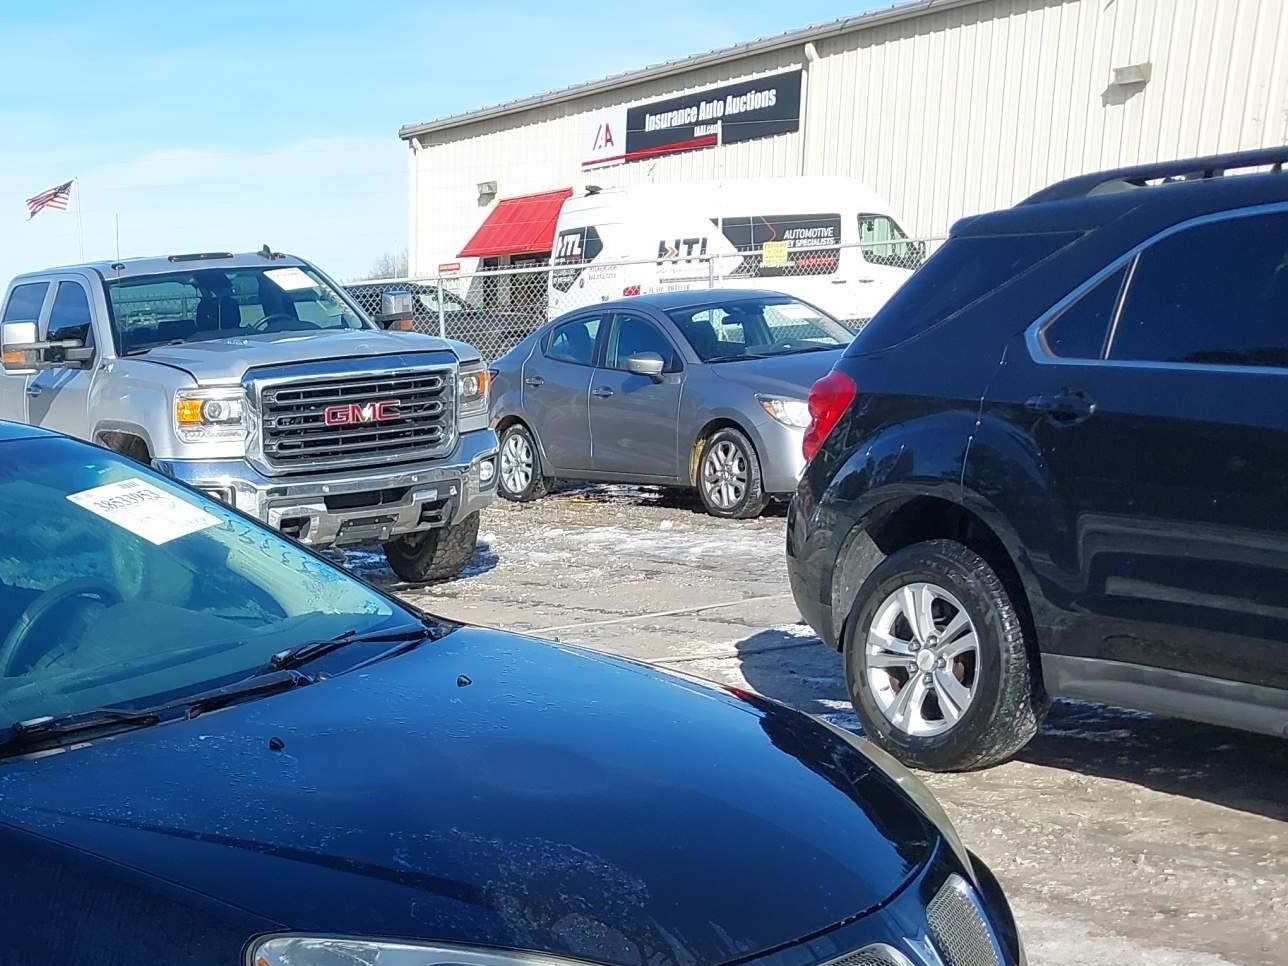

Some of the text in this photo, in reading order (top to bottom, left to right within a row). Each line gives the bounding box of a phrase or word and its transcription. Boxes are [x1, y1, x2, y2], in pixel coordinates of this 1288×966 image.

[645, 89, 776, 132] Insurance Auto Auctions
[783, 226, 834, 239] AUTOMOTIVE
[795, 238, 834, 247] SPECIALISTS
[325, 400, 400, 426] GMC
[92, 489, 161, 512] 38533953
